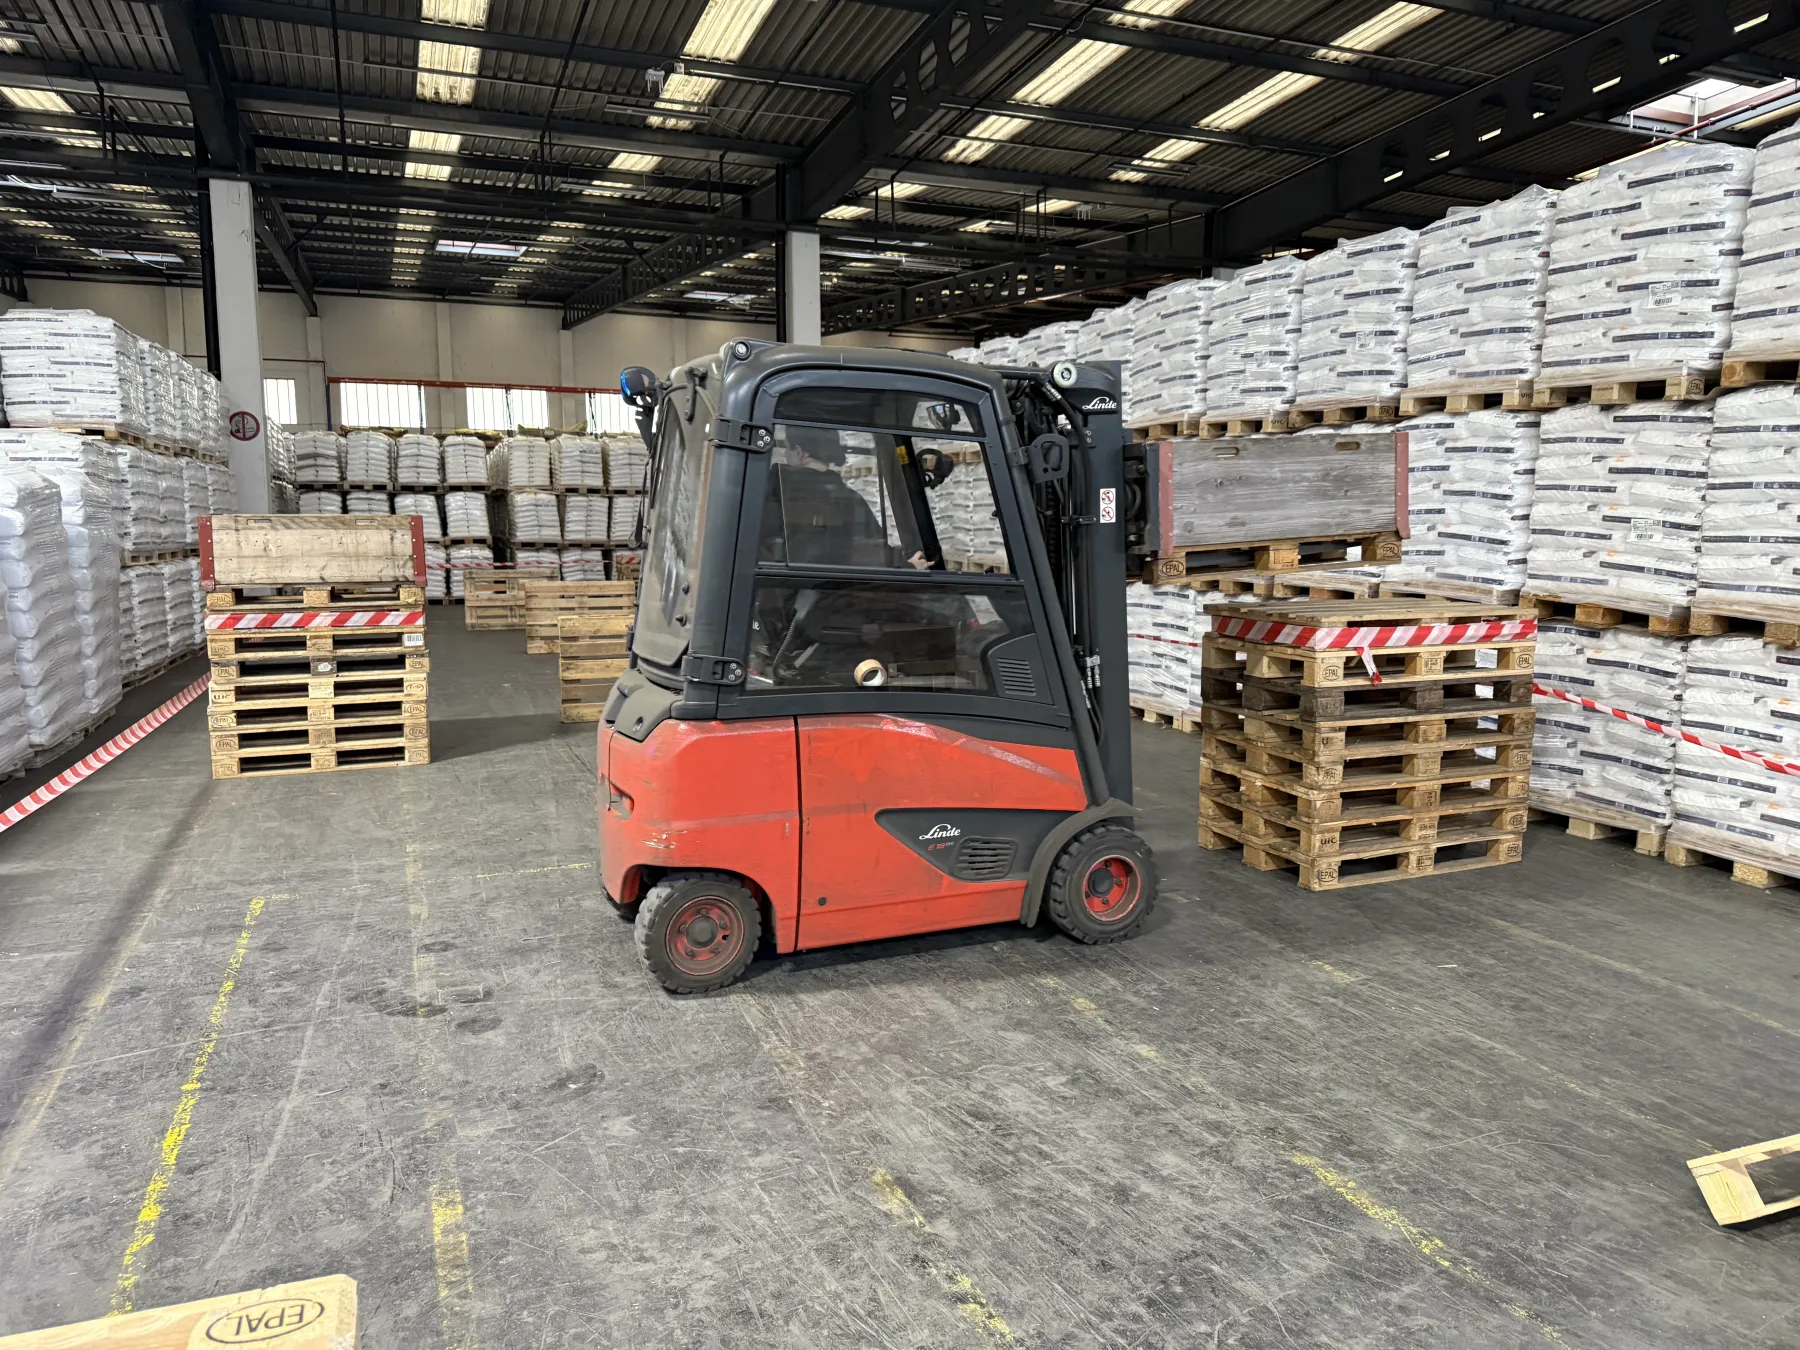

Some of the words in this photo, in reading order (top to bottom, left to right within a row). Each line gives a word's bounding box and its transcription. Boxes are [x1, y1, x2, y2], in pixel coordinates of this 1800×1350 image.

[1082, 396, 1117, 410] Linde
[1165, 563, 1183, 573] EPAL
[1518, 657, 1530, 665] EPAL
[1324, 668, 1338, 677] EPAL
[918, 823, 961, 840] Linde
[1506, 845, 1519, 854] EPAL
[1319, 870, 1335, 879] EPAL
[226, 1304, 305, 1337] EPAL
